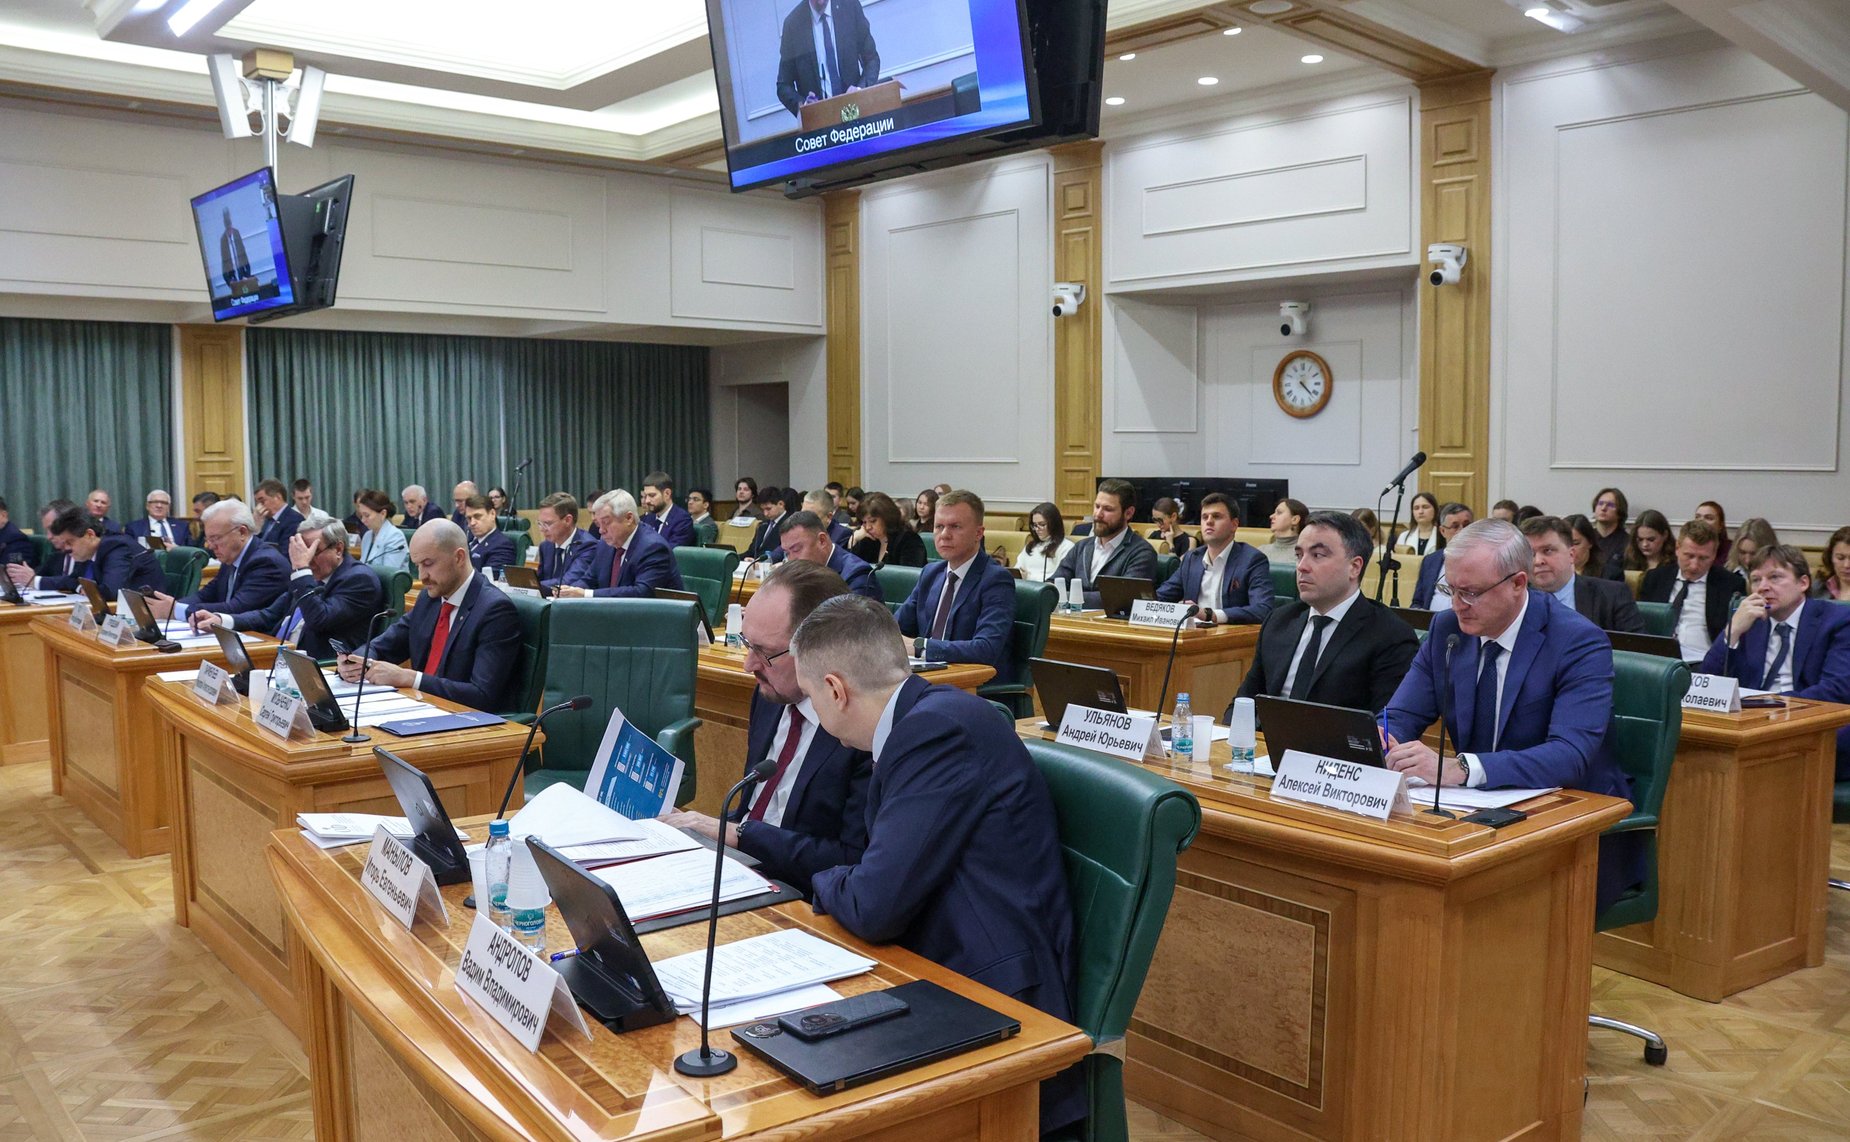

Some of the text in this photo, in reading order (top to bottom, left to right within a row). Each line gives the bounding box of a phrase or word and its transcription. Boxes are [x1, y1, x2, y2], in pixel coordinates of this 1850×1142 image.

[795, 117, 895, 153] Совет Федерации
[1131, 613, 1155, 625] Михаил
[1145, 602, 1176, 614] ВЕДЯКОВ
[1084, 709, 1132, 730] УЛЬЯНОВ
[1061, 724, 1144, 752] Андрей Юрьевич
[1315, 759, 1363, 782] НИДЕНС
[1278, 774, 1388, 811] Алексей Викторович
[381, 836, 414, 877] МАНЫЛОВ
[365, 855, 413, 914] Игорь Евгеньевич
[487, 931, 533, 983] АНДРОПОВ
[461, 949, 540, 1035] Вадим Владимирович
